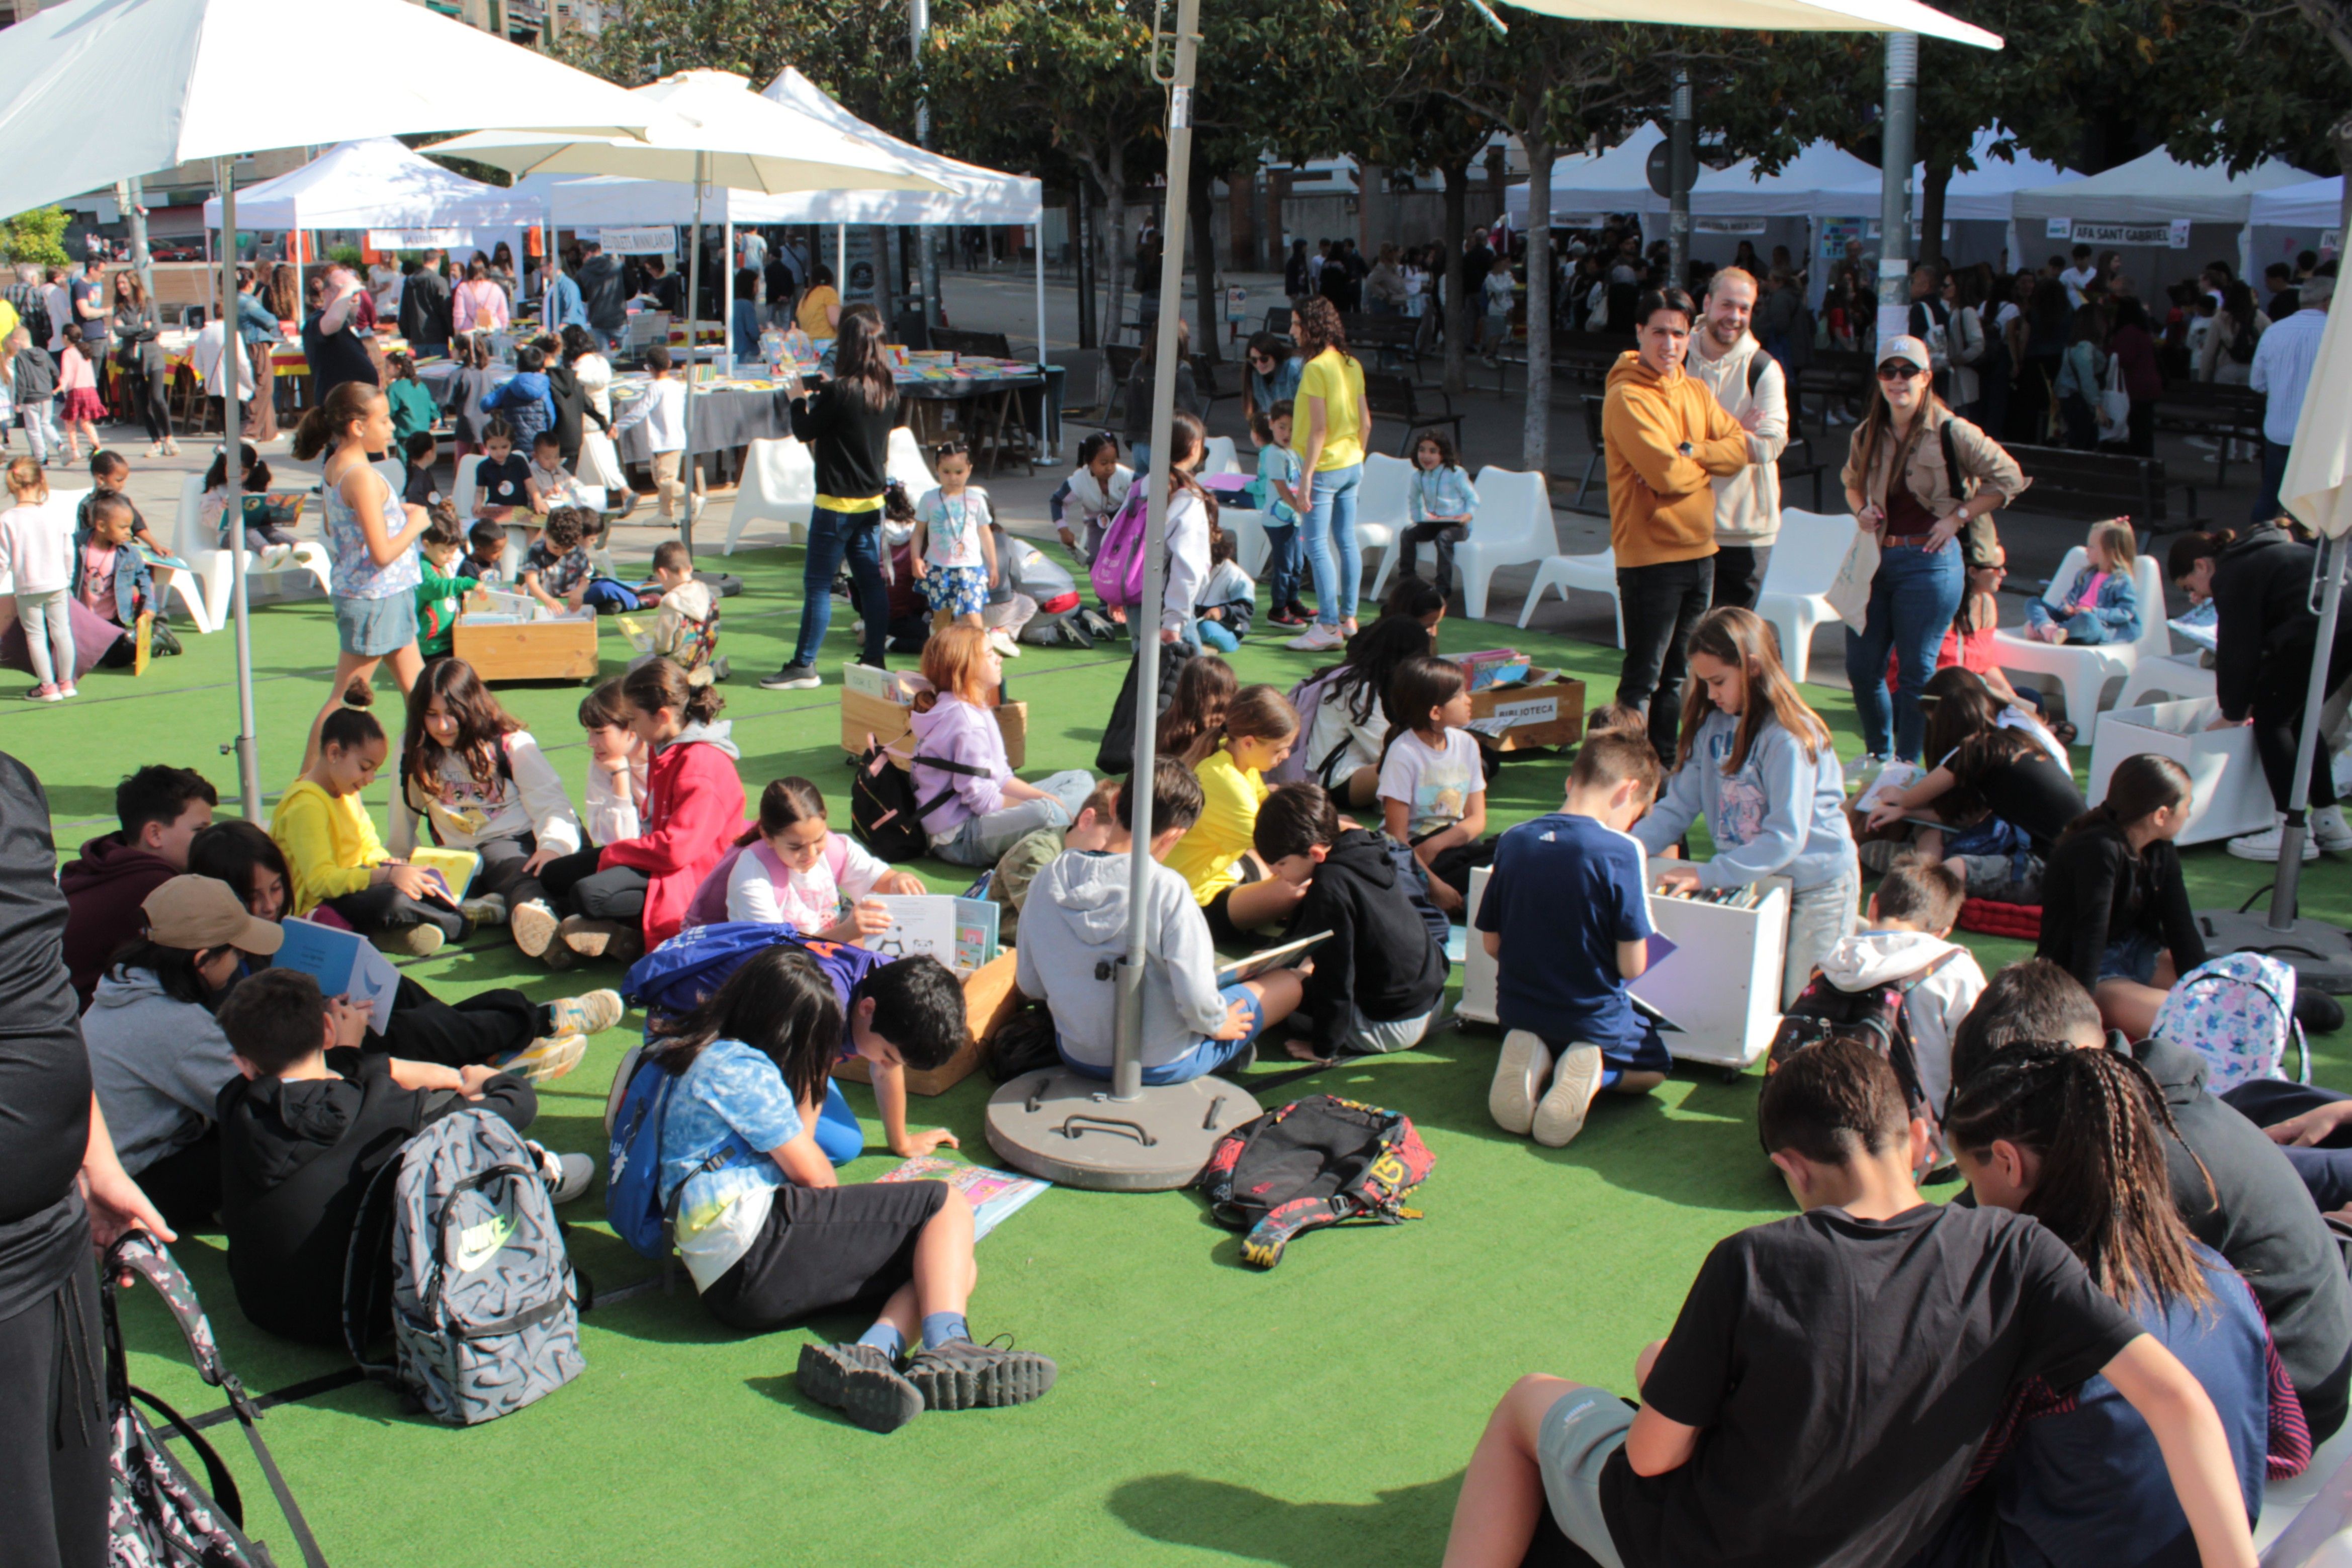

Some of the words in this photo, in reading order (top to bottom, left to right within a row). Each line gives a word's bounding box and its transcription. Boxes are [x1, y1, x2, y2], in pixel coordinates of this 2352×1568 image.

[403, 235, 413, 243] LA
[415, 235, 439, 243] LIBRE
[2077, 227, 2095, 238] AFA
[2097, 228, 2123, 240] SANT
[2126, 229, 2168, 241] GABRIEL
[462, 1213, 507, 1254] NIKE
